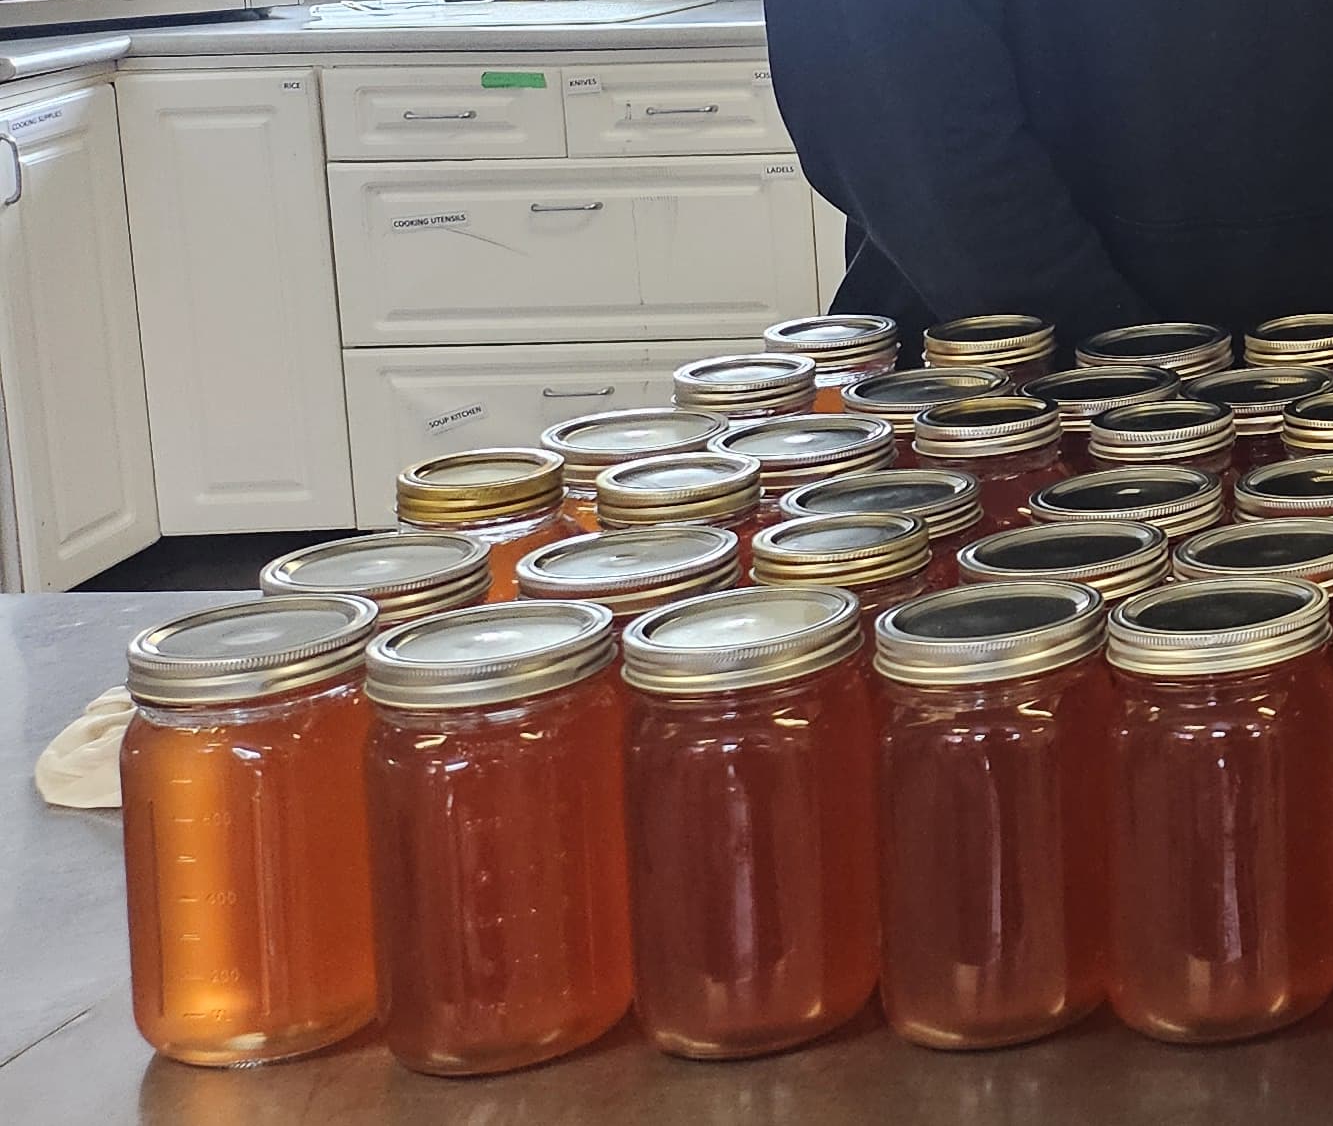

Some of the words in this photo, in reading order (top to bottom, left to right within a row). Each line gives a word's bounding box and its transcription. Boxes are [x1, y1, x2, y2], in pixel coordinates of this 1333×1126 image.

[569, 78, 597, 87] KNIVES
[393, 217, 429, 228] COOKING
[430, 214, 466, 224] UTENSILS
[428, 417, 449, 428] SOUP
[450, 405, 482, 421] KITCHEN
